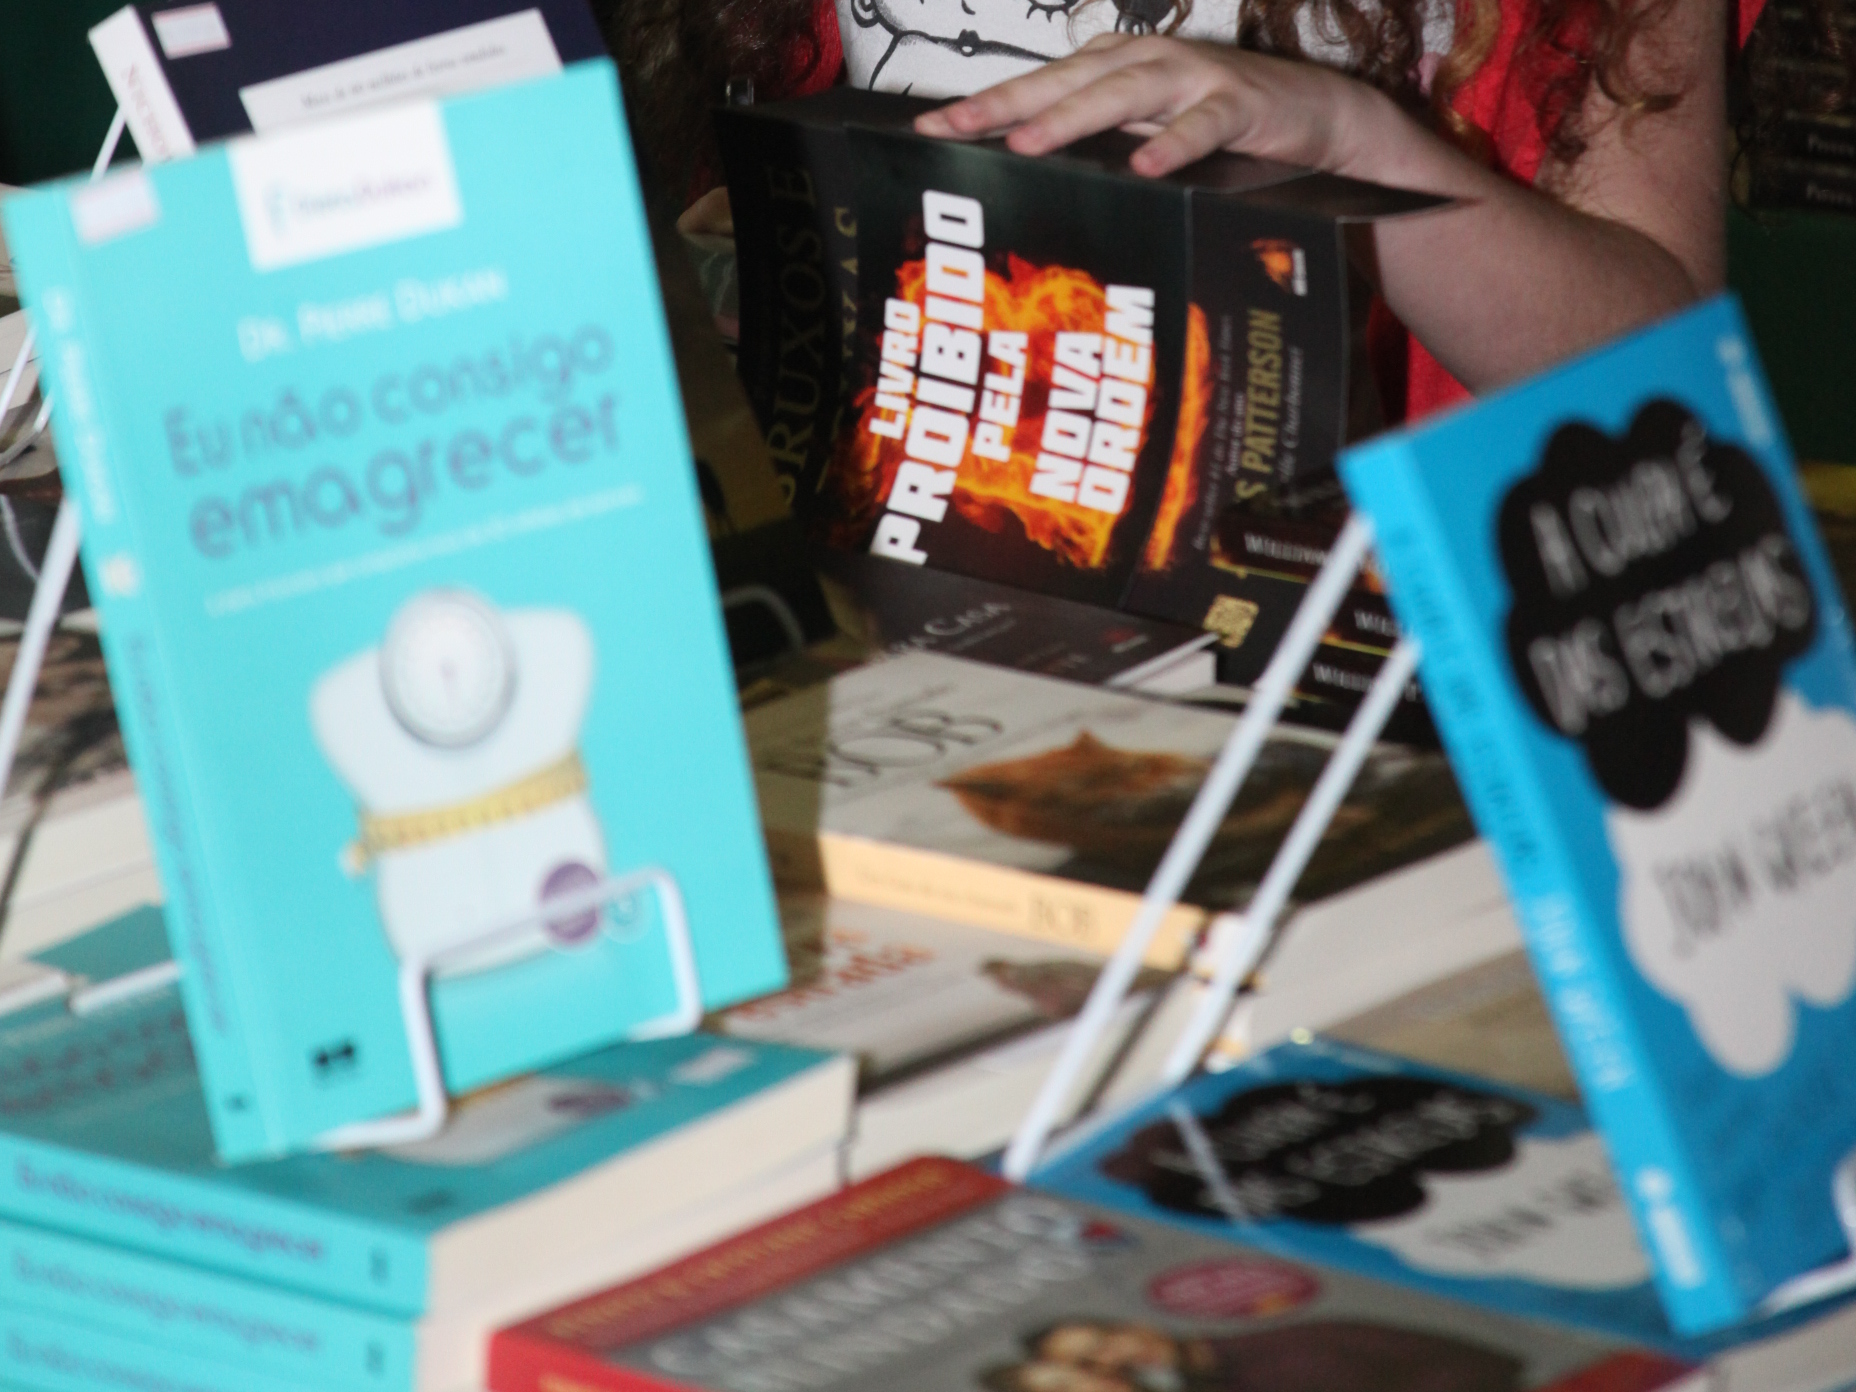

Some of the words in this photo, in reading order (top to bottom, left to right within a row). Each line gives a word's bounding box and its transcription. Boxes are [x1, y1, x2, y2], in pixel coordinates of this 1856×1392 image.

[163, 405, 234, 477] Eu
[240, 383, 363, 454] não
[370, 322, 616, 423] consigo
[868, 189, 984, 565] PROIBIDO
[869, 297, 921, 439] LIVRO
[971, 330, 1029, 463] PELA
[1029, 331, 1101, 502] NOVA
[1077, 285, 1155, 515] ORDEM
[1243, 307, 1282, 475] PATTERSON
[188, 393, 621, 558] emagrecer
